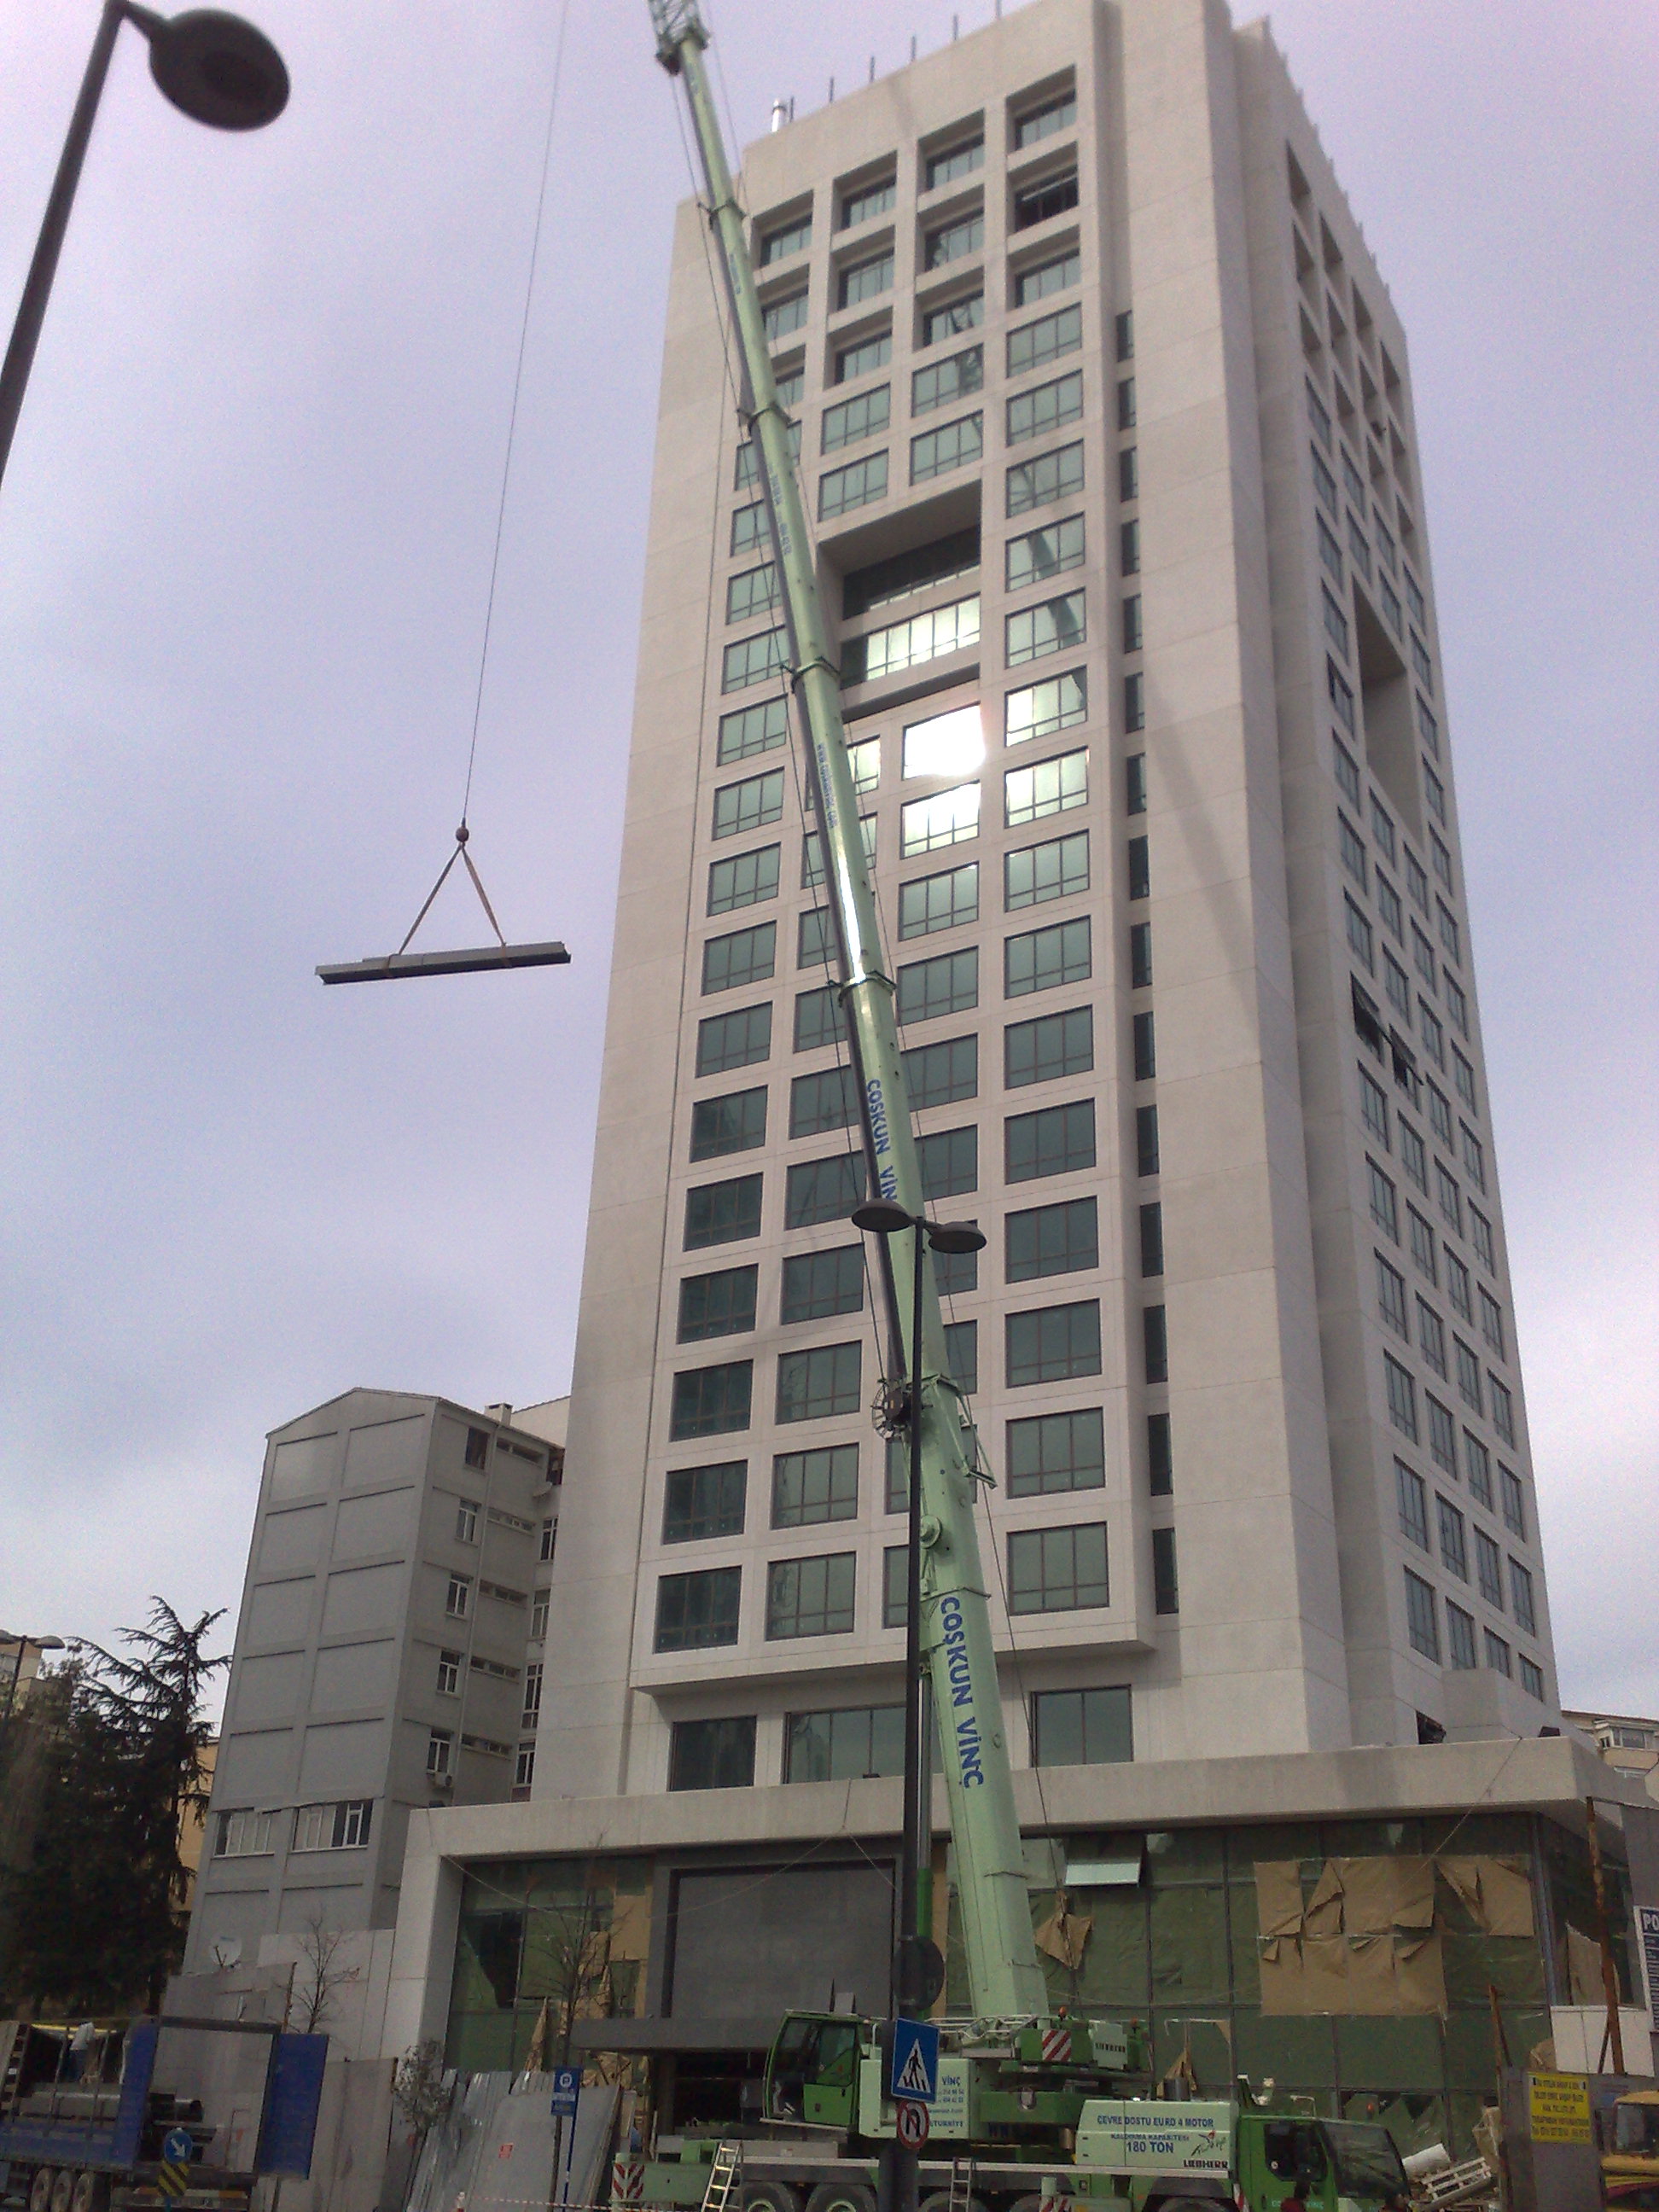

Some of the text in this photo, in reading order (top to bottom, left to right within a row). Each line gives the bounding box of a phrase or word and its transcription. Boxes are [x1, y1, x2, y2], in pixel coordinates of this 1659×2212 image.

[1124, 2116, 1151, 2126] DOSTU
[1153, 2116, 1176, 2127] EURO
[1185, 2117, 1214, 2128] MOTOR
[1127, 2140, 1174, 2153] 180 TON
